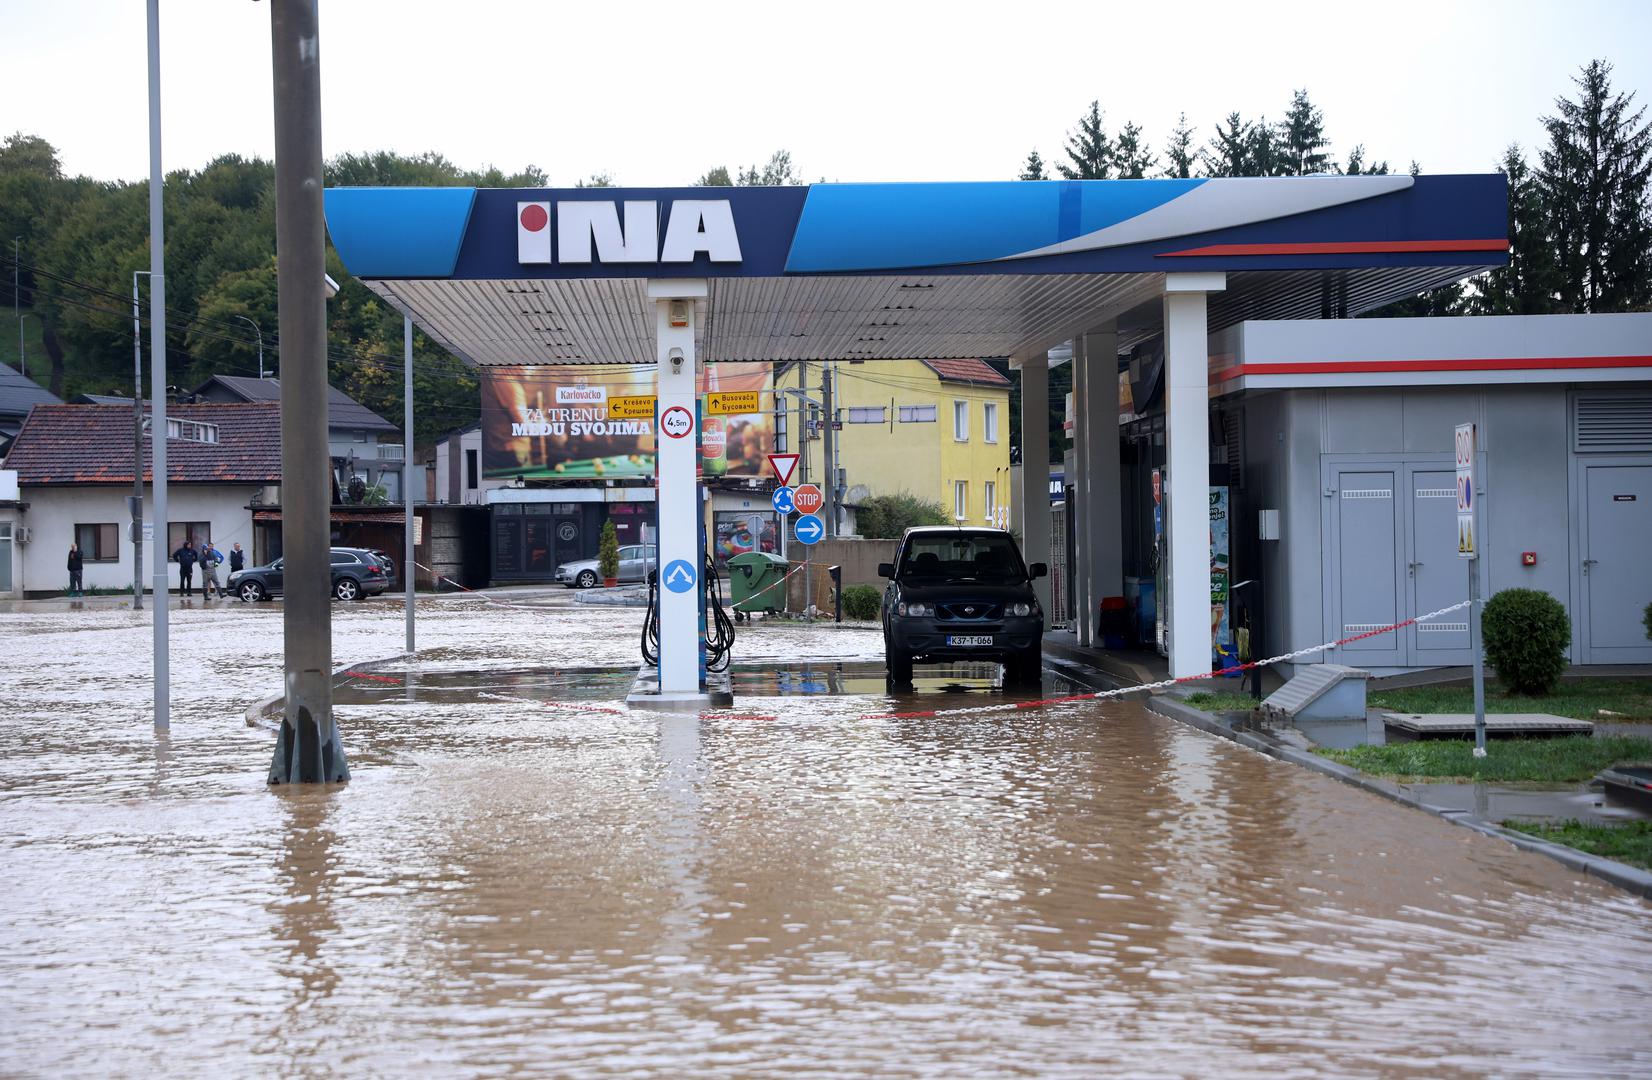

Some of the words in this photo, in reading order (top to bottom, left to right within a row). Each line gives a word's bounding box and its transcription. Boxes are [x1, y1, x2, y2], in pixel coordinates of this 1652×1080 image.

[517, 199, 743, 263] INA
[560, 390, 601, 400] Karlovačko
[523, 408, 545, 421] ZA
[667, 417, 687, 427] 4,5m
[570, 422, 651, 436] SVOJIMA
[797, 493, 819, 506] STOP
[717, 522, 734, 530] print
[951, 636, 992, 645] K37-T-066
